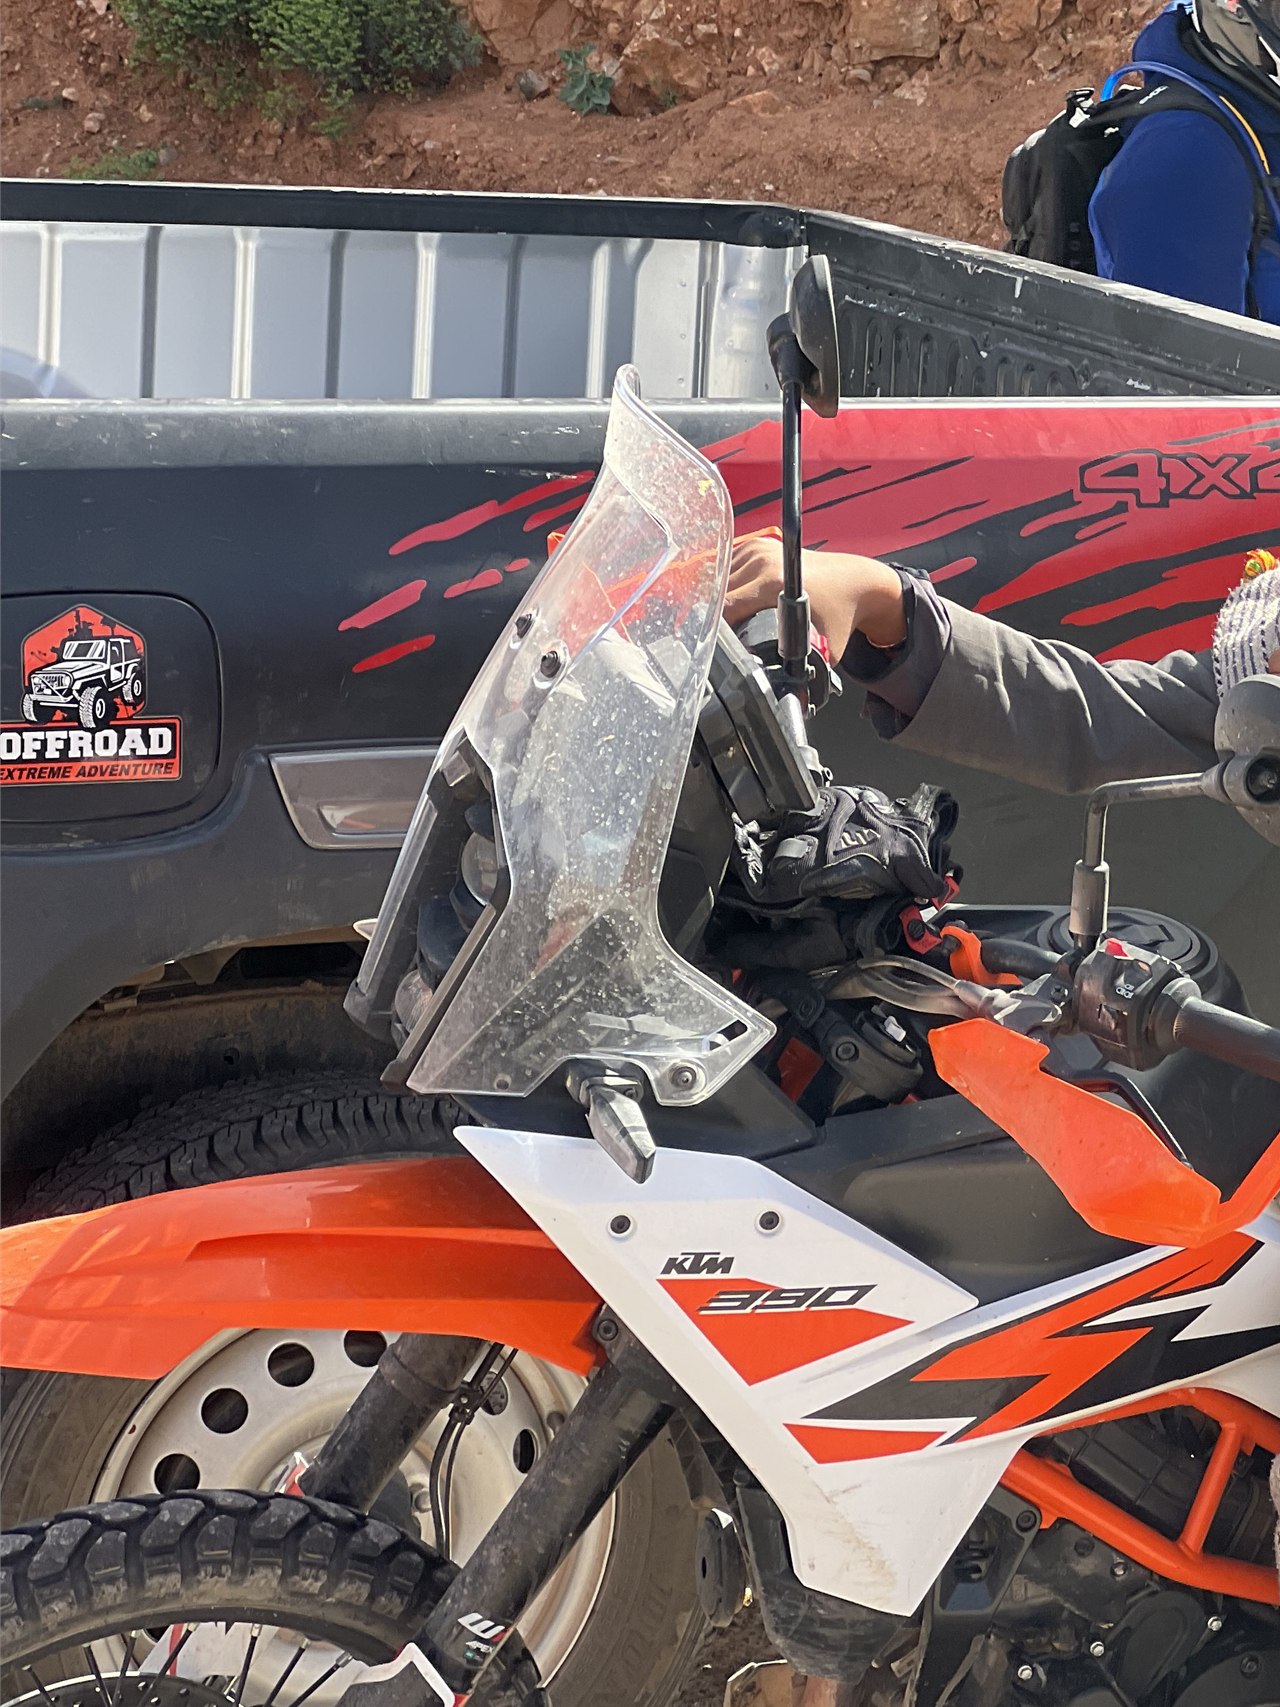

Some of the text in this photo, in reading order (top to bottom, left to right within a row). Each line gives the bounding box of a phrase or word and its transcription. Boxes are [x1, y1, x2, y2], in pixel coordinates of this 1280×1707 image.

[0, 727, 172, 760] OFFROAD
[75, 762, 175, 779] ADVENTURE
[660, 1251, 735, 1275] KTM
